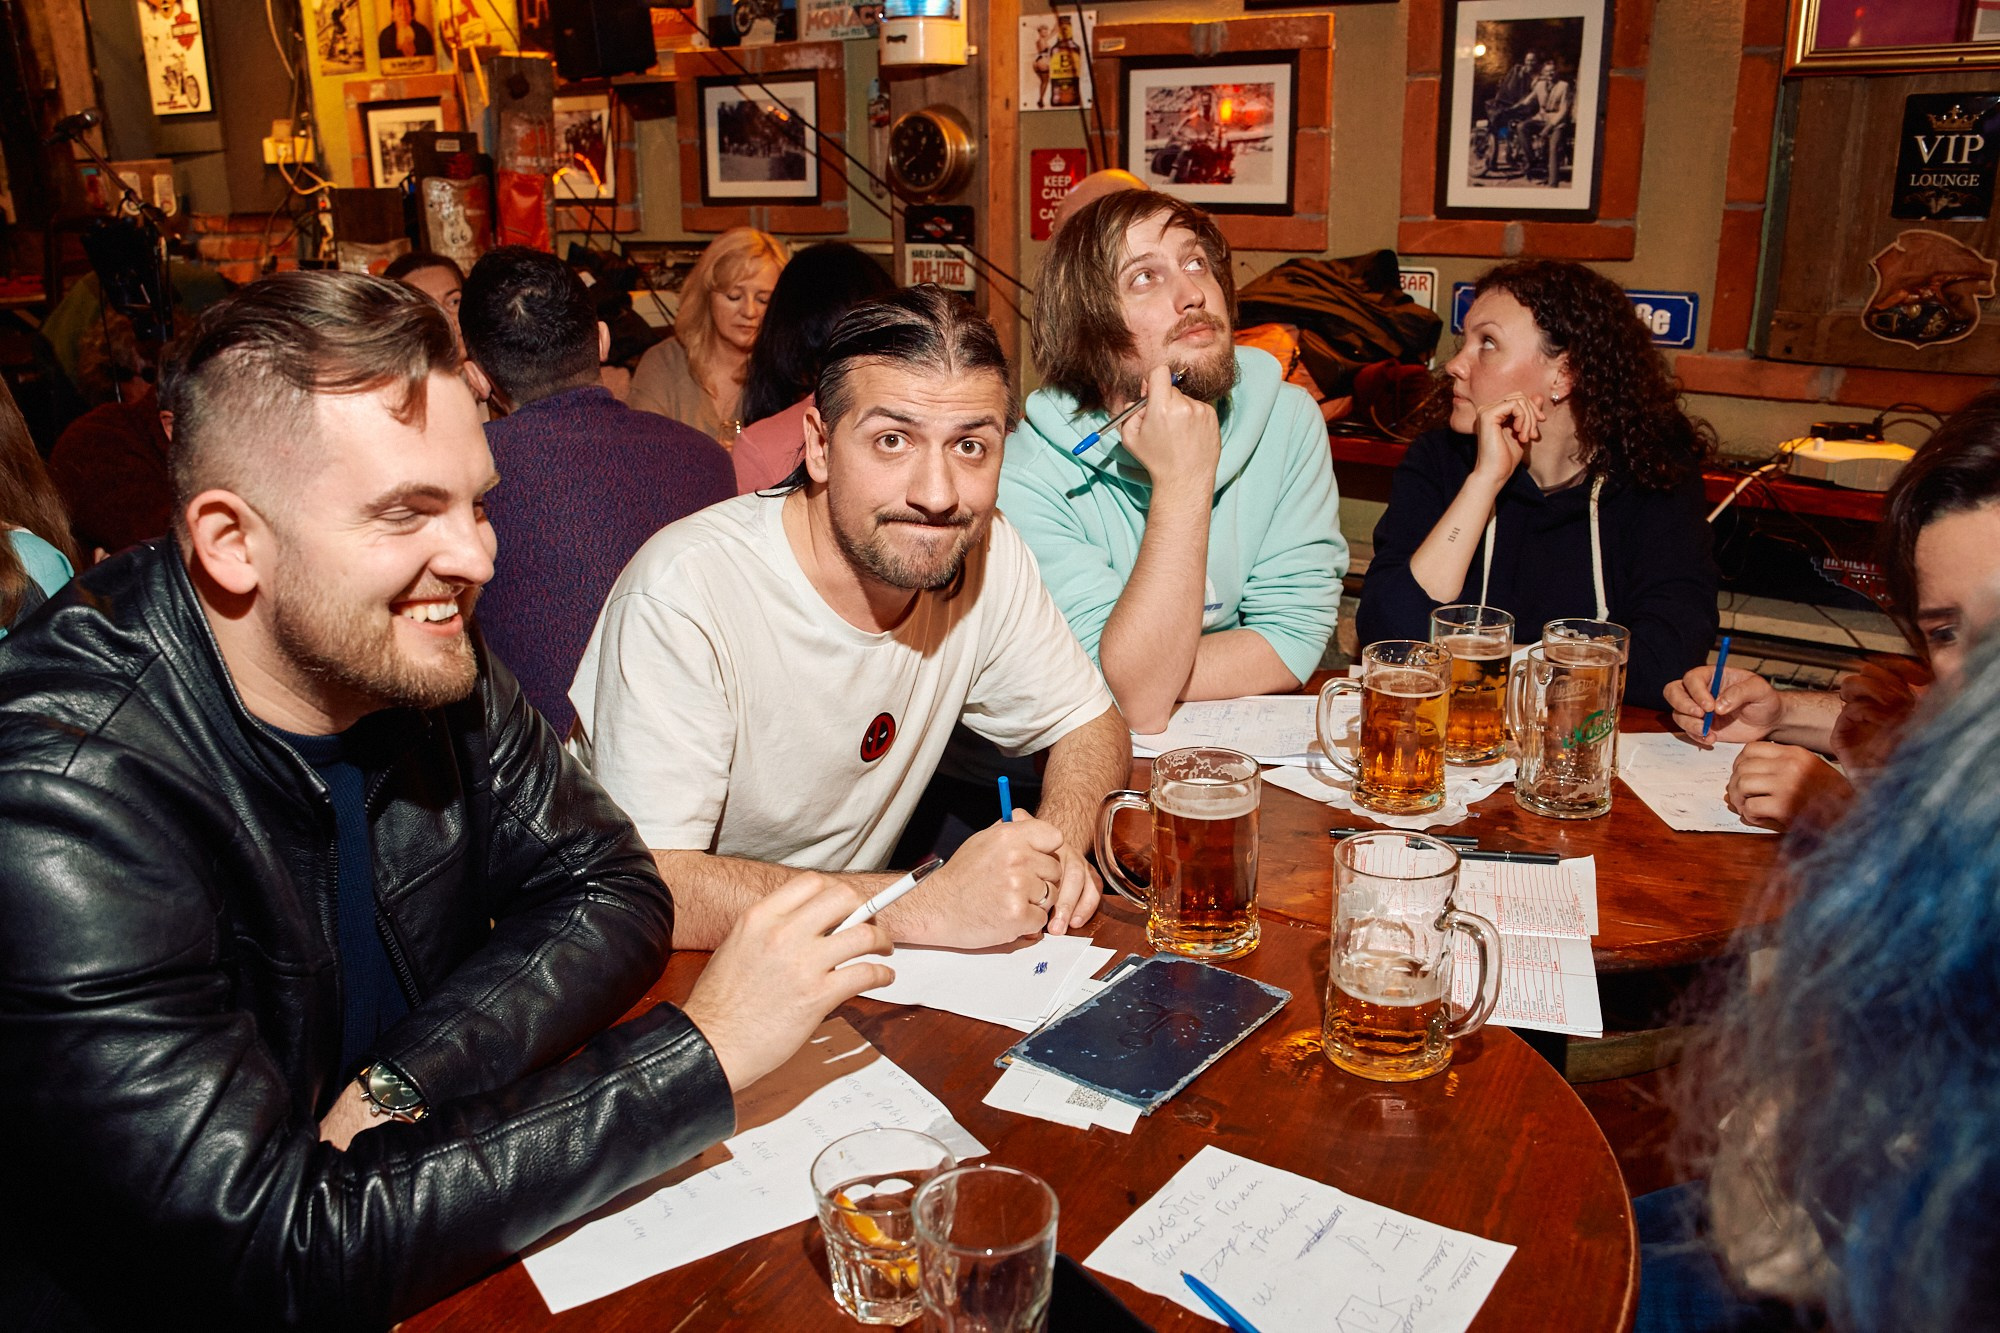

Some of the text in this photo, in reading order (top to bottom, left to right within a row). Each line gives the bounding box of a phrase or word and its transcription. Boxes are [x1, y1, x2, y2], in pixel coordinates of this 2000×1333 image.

[1914, 134, 1985, 164] VIP
[1043, 175, 1072, 187] KEEP
[1910, 174, 1980, 187] LOUNGE
[912, 260, 965, 285] PRE-LUXE
